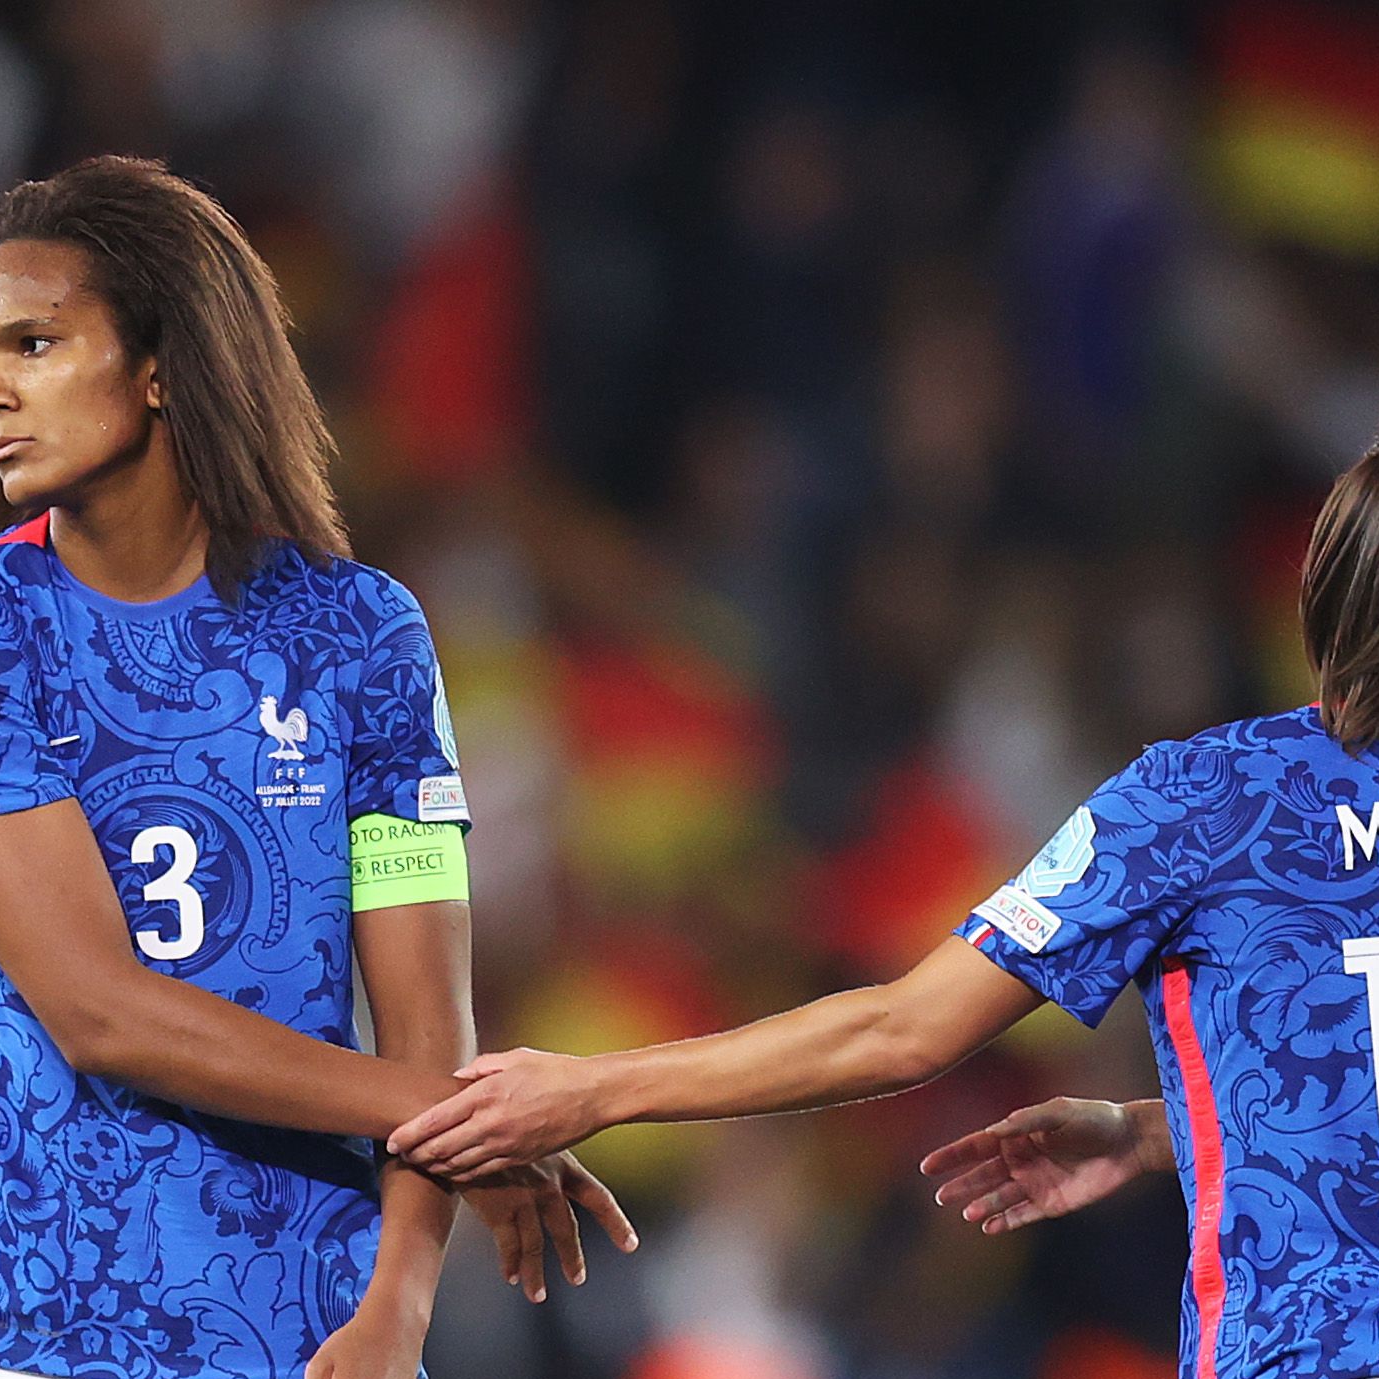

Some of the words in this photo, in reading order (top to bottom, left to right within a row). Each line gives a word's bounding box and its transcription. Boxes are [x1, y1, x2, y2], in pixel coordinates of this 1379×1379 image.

[301, 784, 326, 794] FRANCE
[262, 797, 273, 808] 27
[300, 796, 321, 806] 2022
[423, 791, 463, 806] FOUN
[361, 828, 383, 843] TO
[388, 823, 446, 839] RACISM
[371, 853, 444, 876] RESPECT
[130, 825, 206, 961] 3
